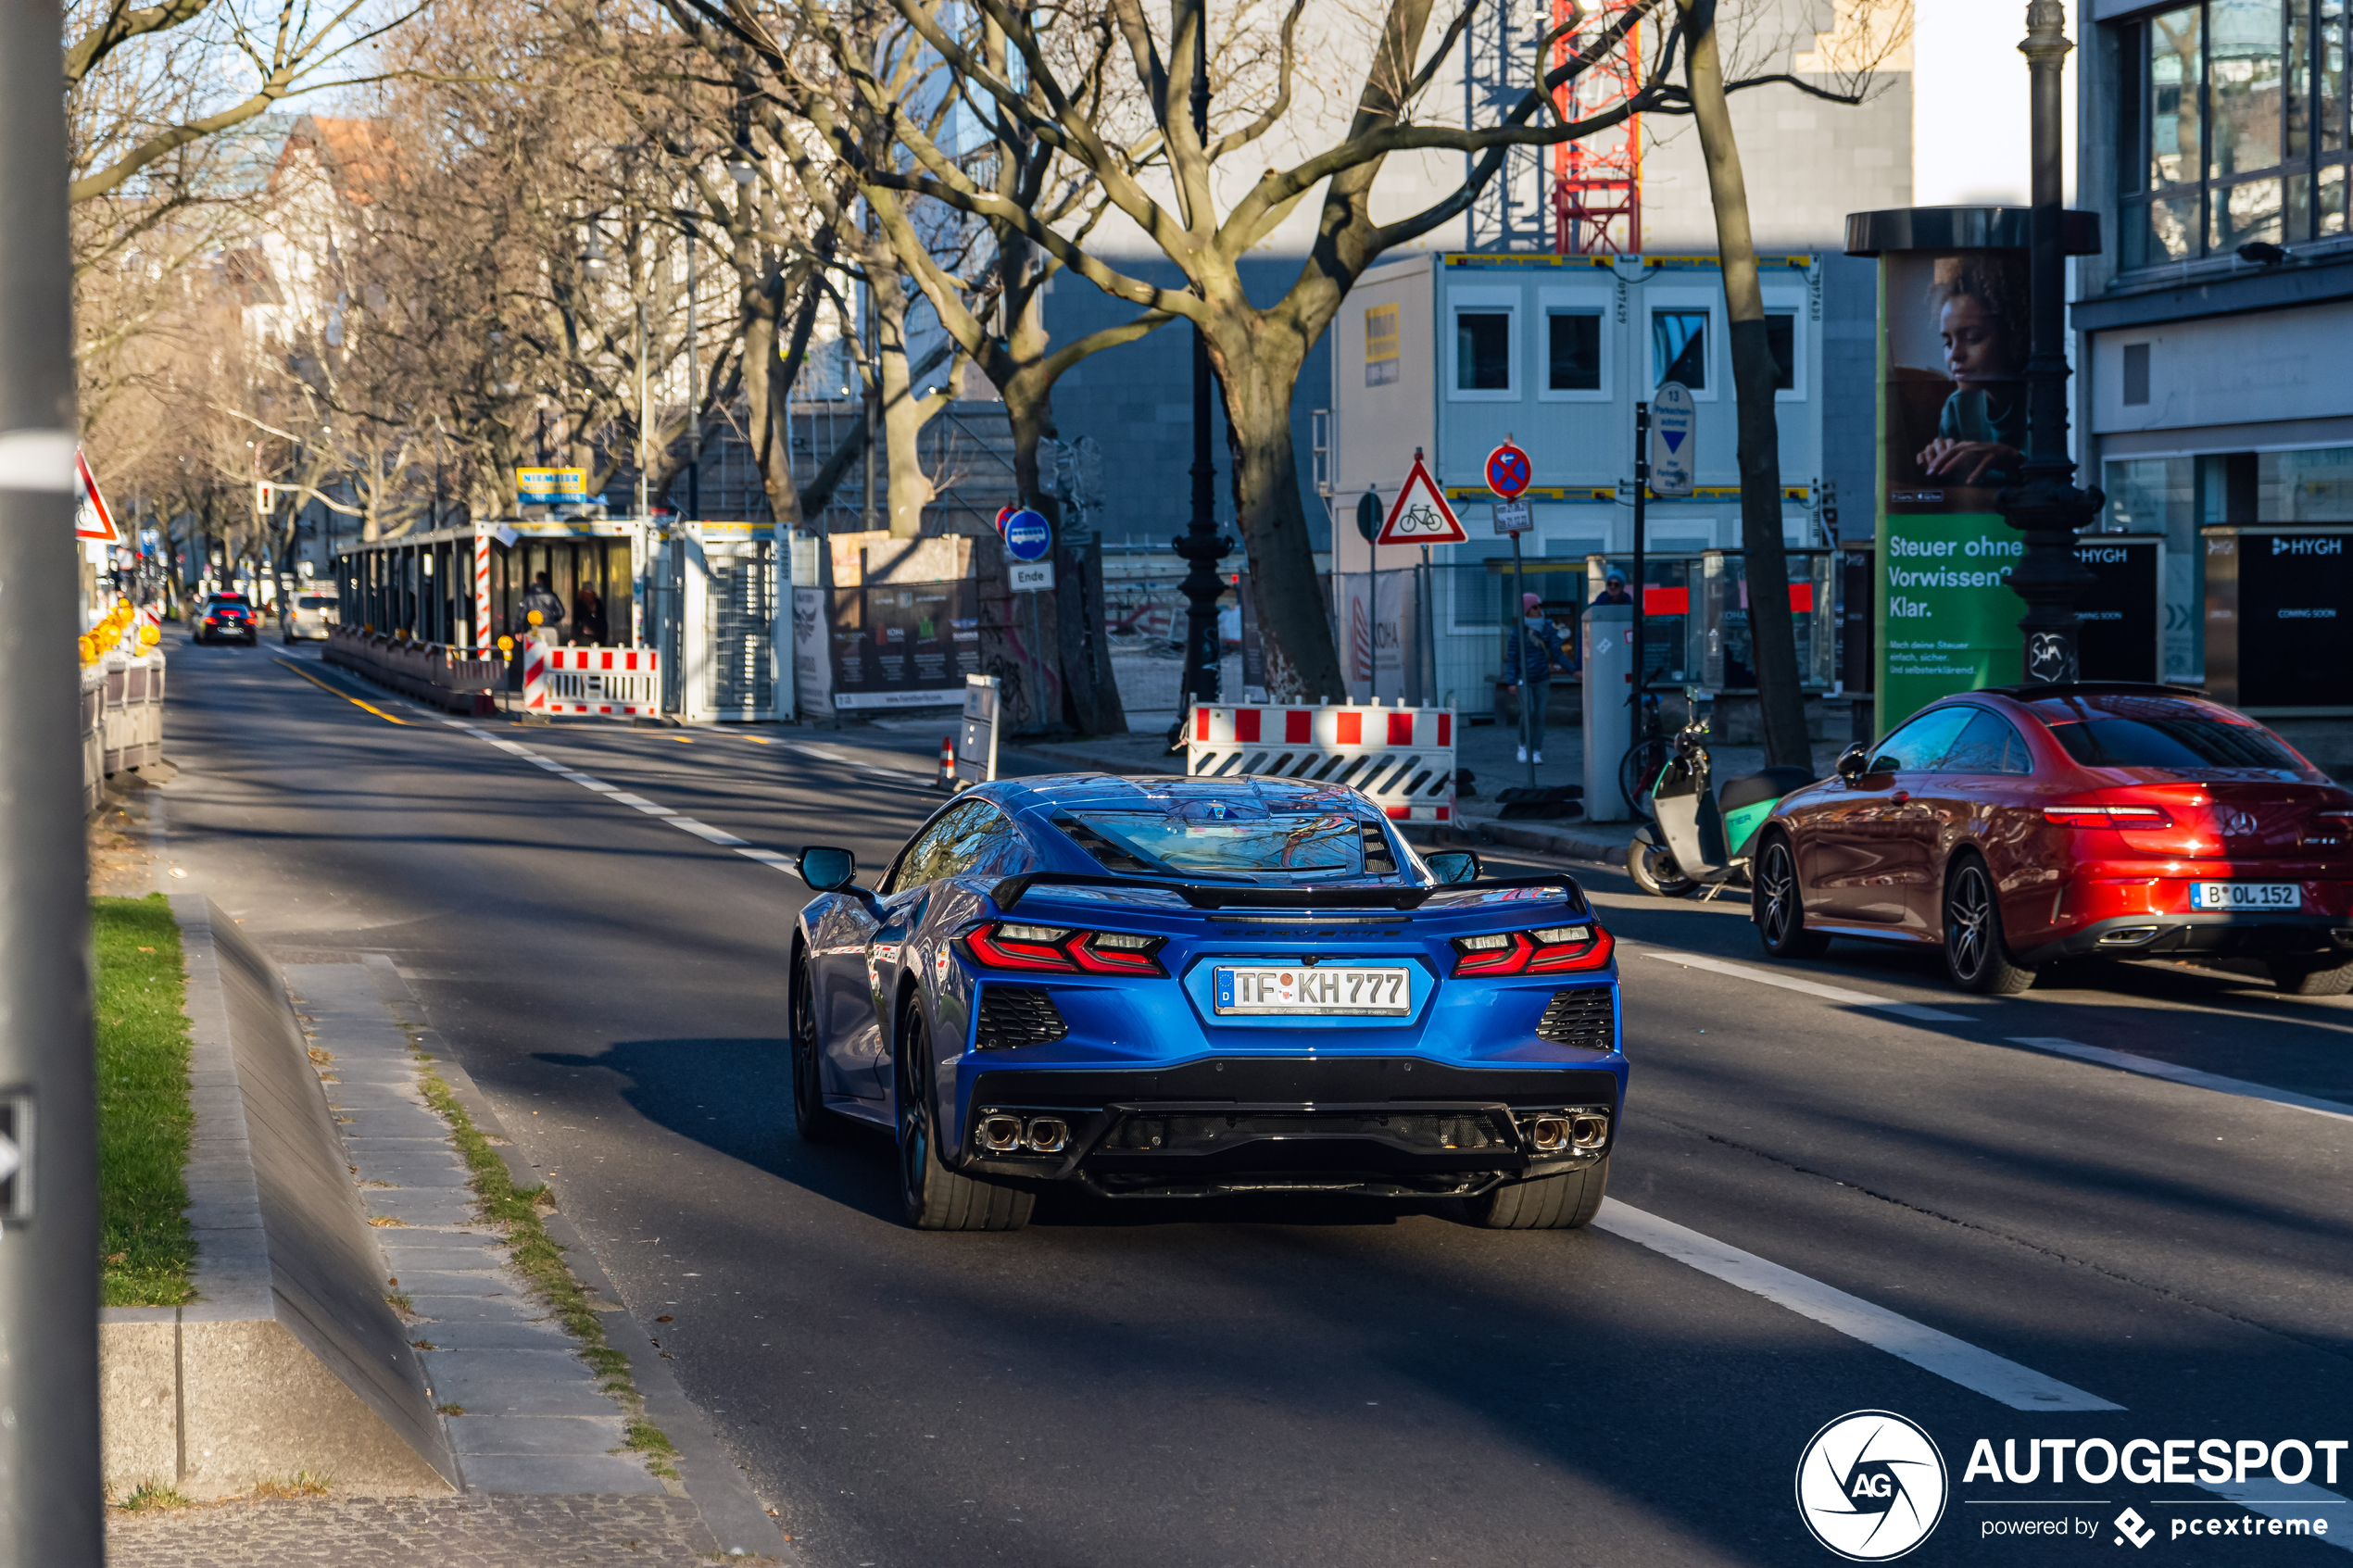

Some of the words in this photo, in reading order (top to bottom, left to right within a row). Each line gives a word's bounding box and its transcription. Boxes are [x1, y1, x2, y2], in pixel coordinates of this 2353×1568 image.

[1668, 390, 1680, 402] 13
[1890, 535, 1957, 557] Steuer
[1964, 535, 2023, 557] ohne
[2291, 538, 2341, 555] HYGH
[2082, 548, 2127, 562] HYGH
[1017, 571, 1044, 583] Ende
[1890, 596, 1931, 618] Klar.
[2277, 608, 2310, 619] COMING
[2312, 608, 2336, 619] SOON
[1937, 641, 1969, 649] Steuer
[2209, 886, 2220, 903] B
[2233, 886, 2256, 904] OL
[2260, 886, 2293, 904] 152
[1236, 972, 1277, 1003] TF
[1299, 973, 1340, 1004] KH
[1346, 973, 1403, 1004] 777
[1222, 992, 1229, 1001] D
